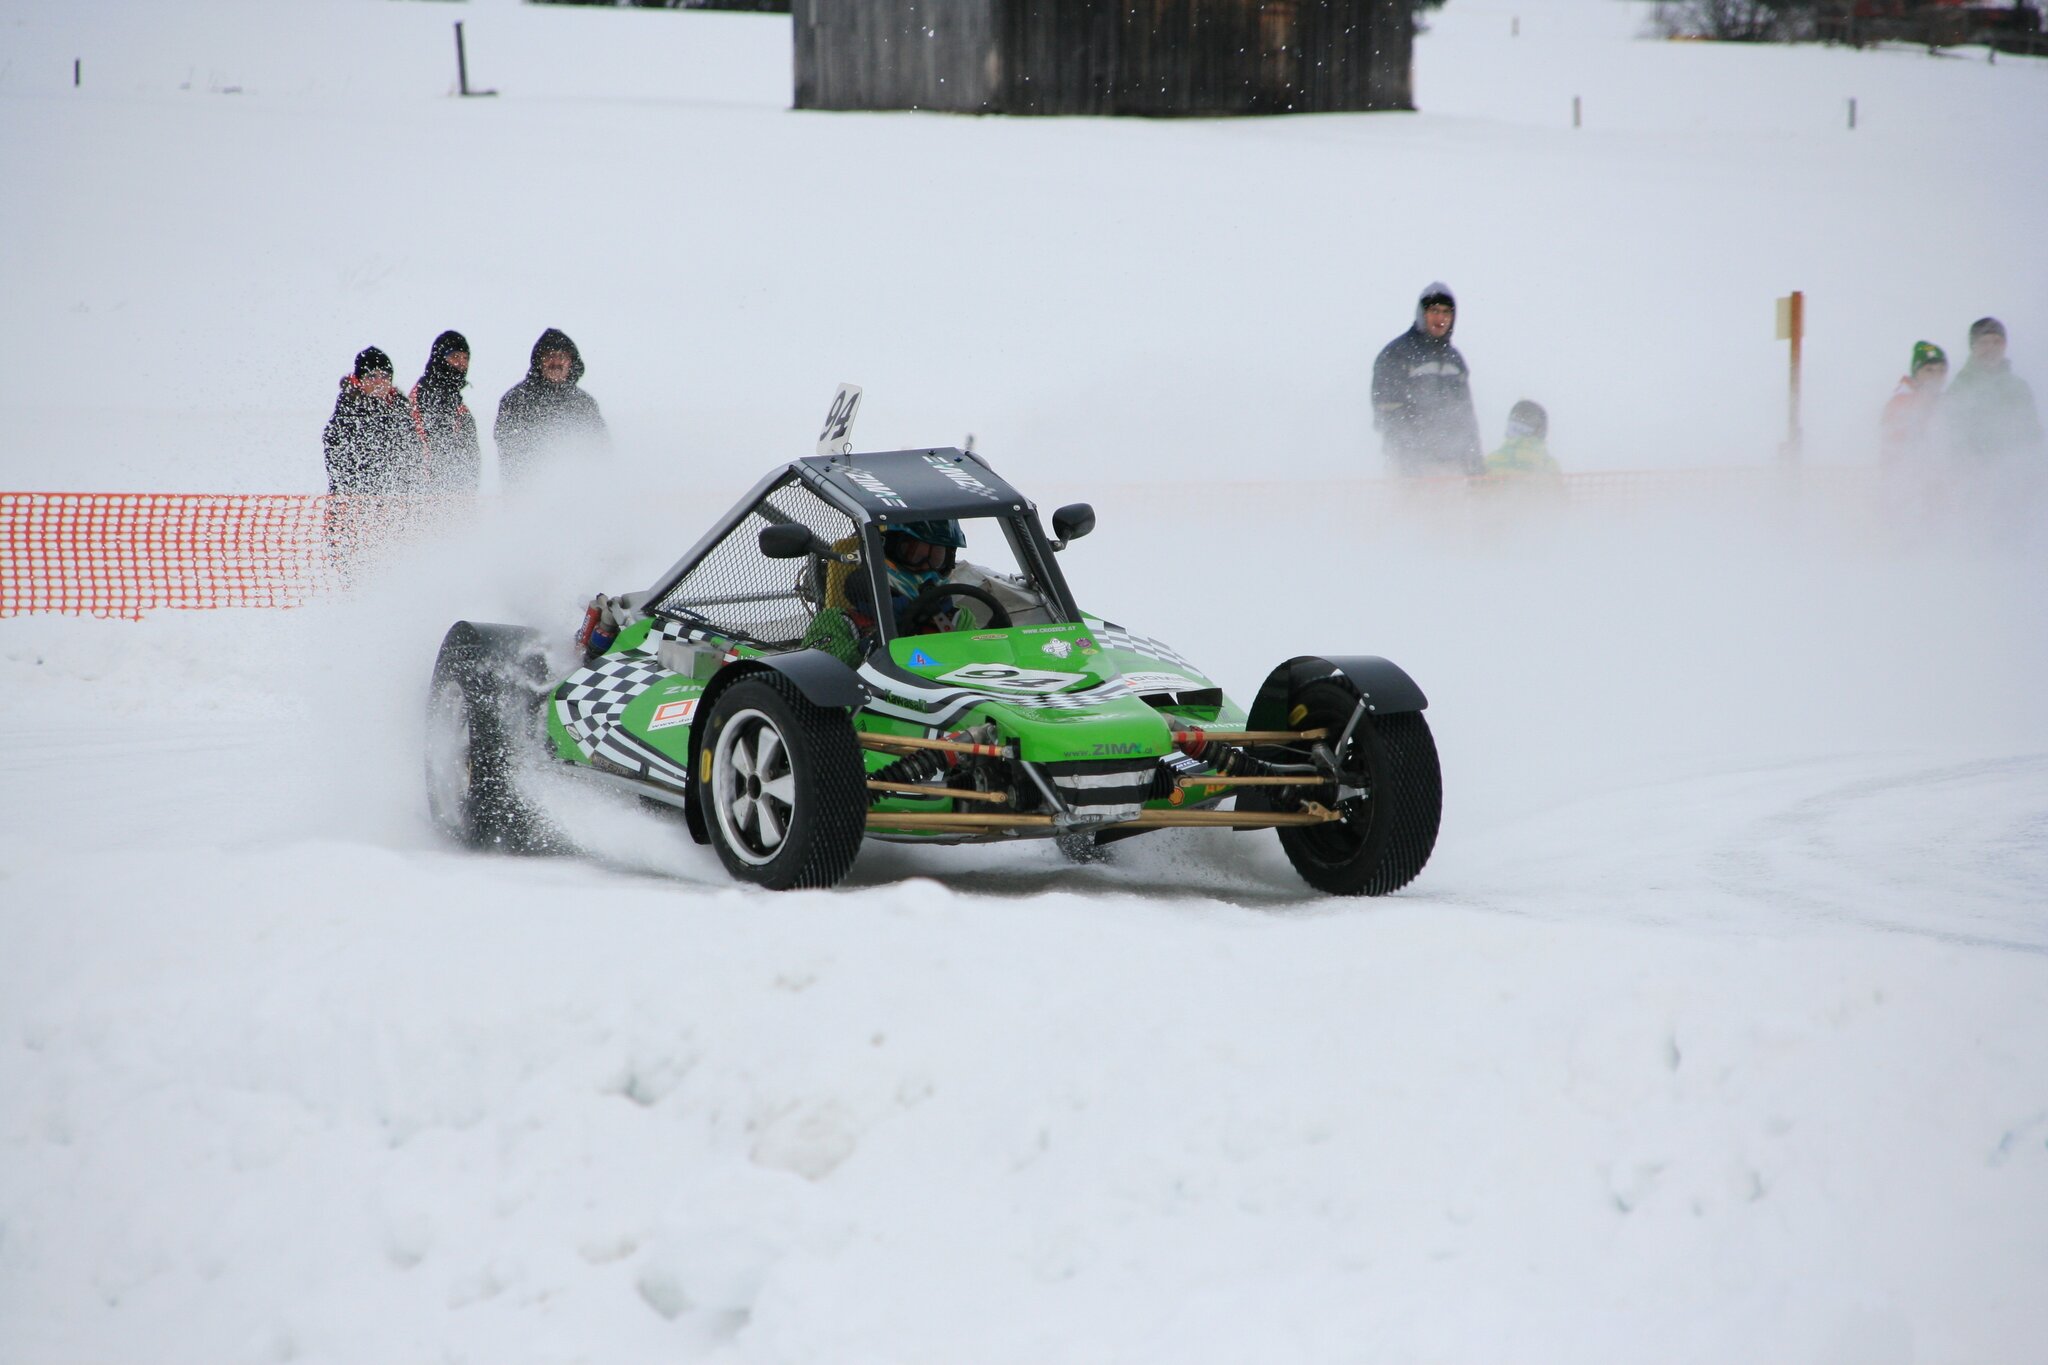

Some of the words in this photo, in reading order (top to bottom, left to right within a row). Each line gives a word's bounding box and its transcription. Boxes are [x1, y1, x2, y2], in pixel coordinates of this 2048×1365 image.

[820, 390, 860, 441] 94
[844, 471, 902, 500] ZIMA
[954, 669, 1067, 688] 94
